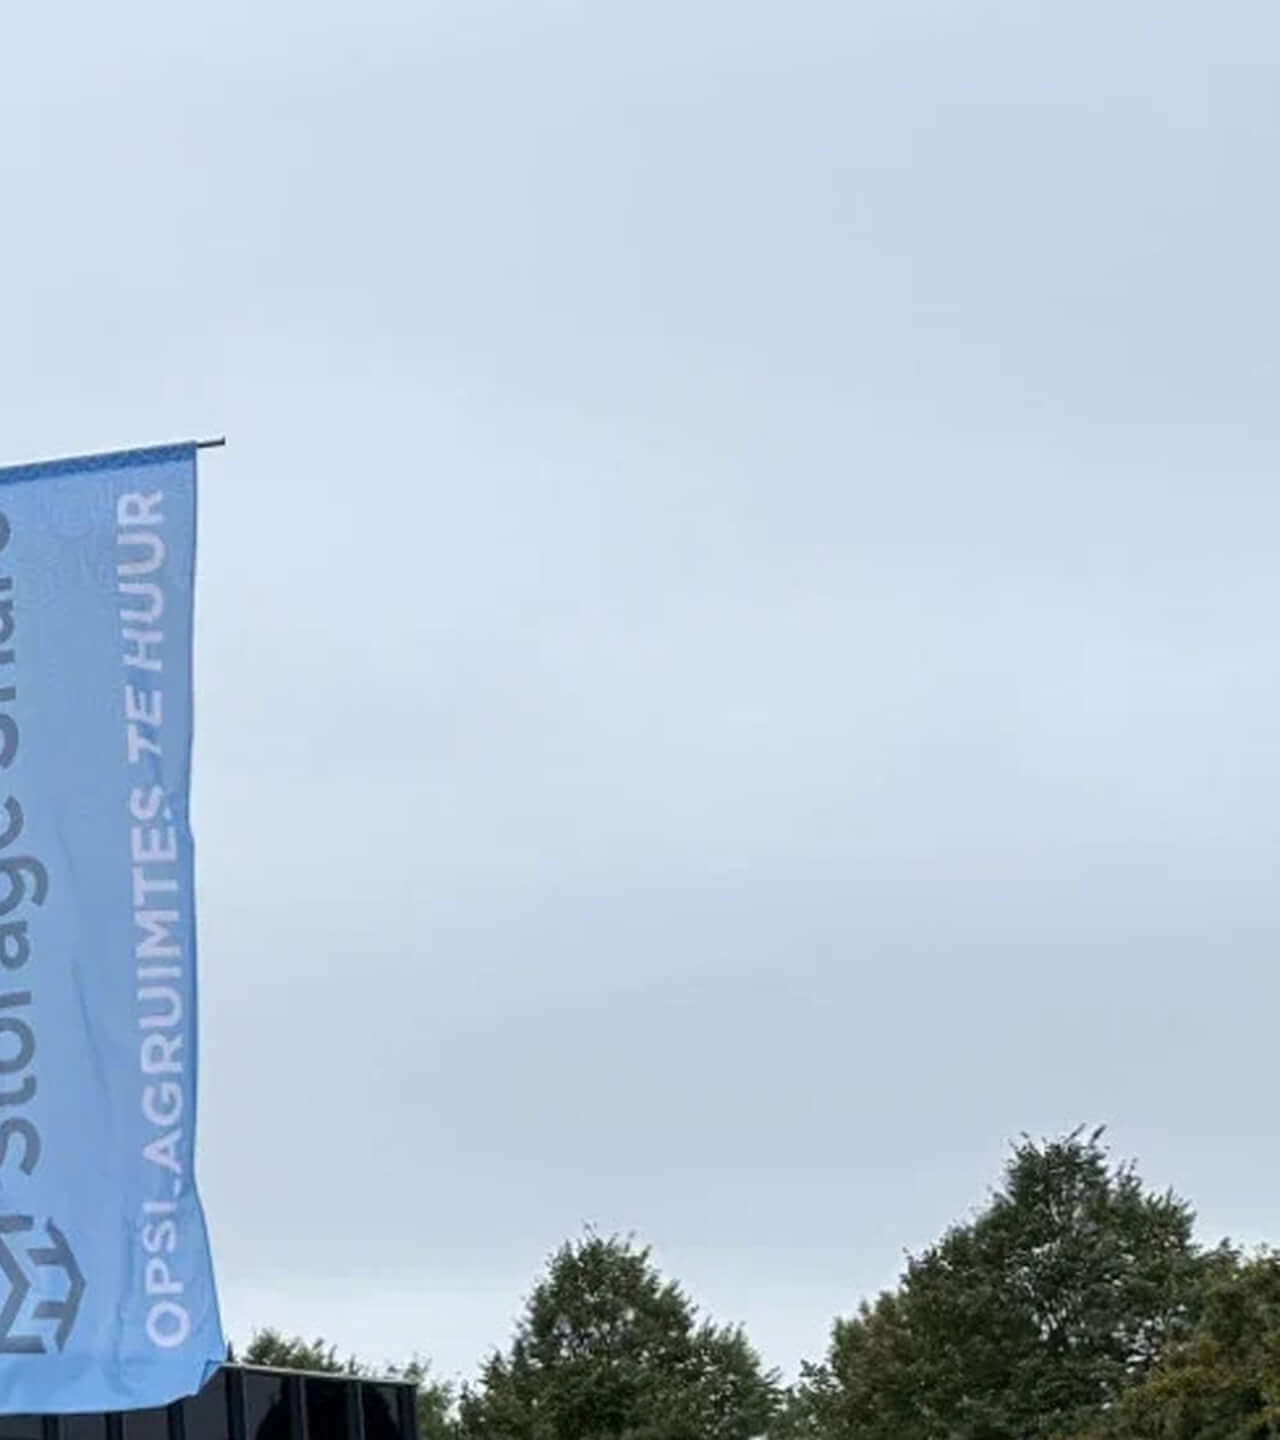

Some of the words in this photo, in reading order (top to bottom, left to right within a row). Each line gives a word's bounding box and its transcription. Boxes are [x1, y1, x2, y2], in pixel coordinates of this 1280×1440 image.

[117, 489, 164, 672] HUUR
[125, 684, 163, 764] TE
[131, 784, 189, 1348] OPSLAGRUIMTES
